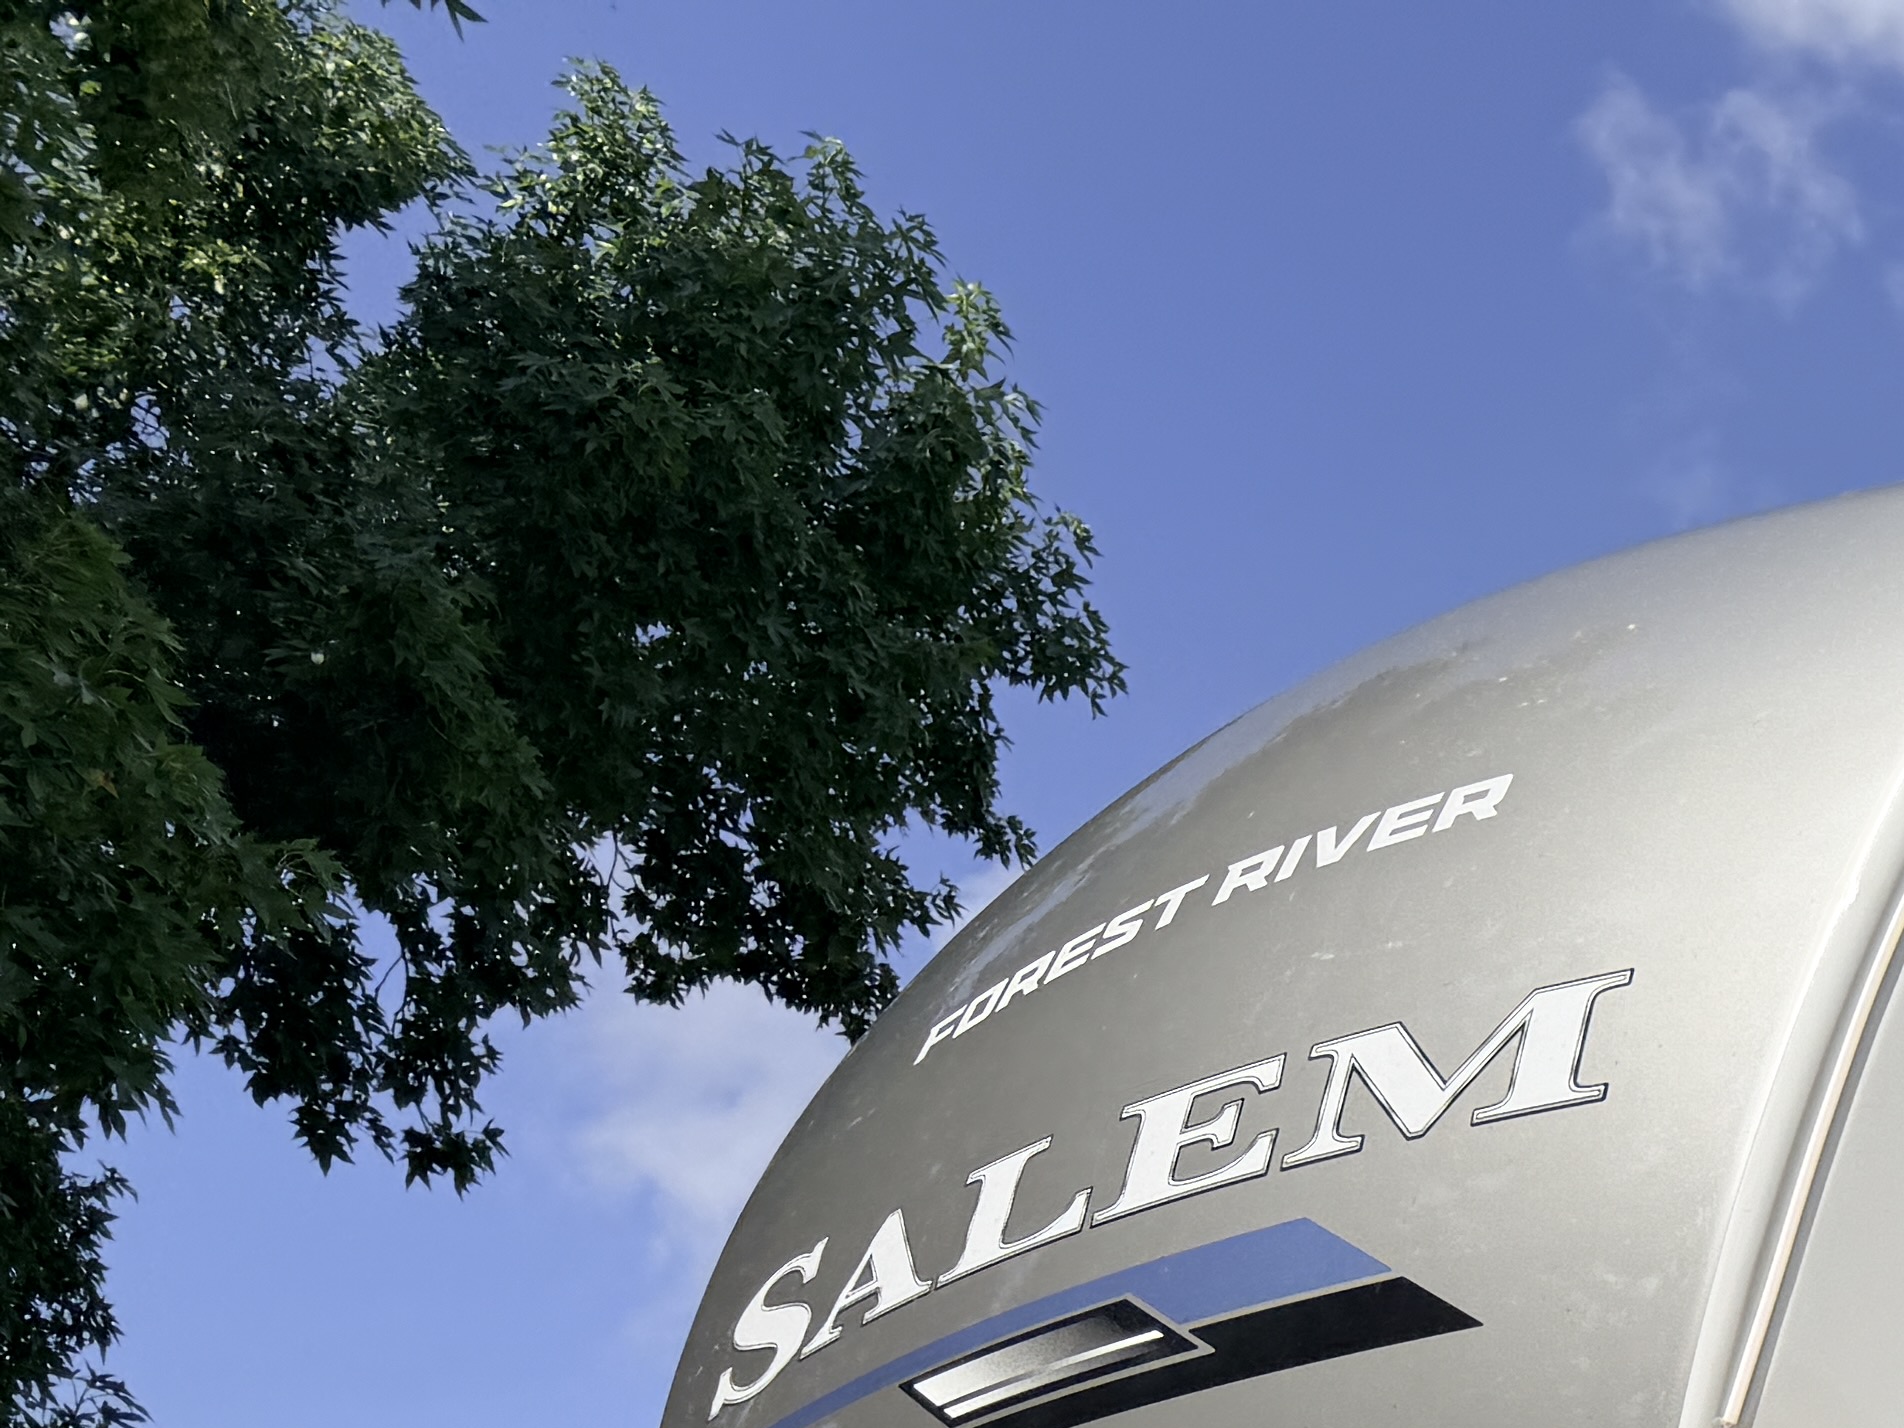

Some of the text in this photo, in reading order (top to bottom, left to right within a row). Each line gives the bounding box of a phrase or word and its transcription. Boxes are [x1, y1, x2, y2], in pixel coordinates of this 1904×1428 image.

[912, 774, 1514, 1065] FOREST RIVER
[708, 968, 1634, 1421] SALEM
